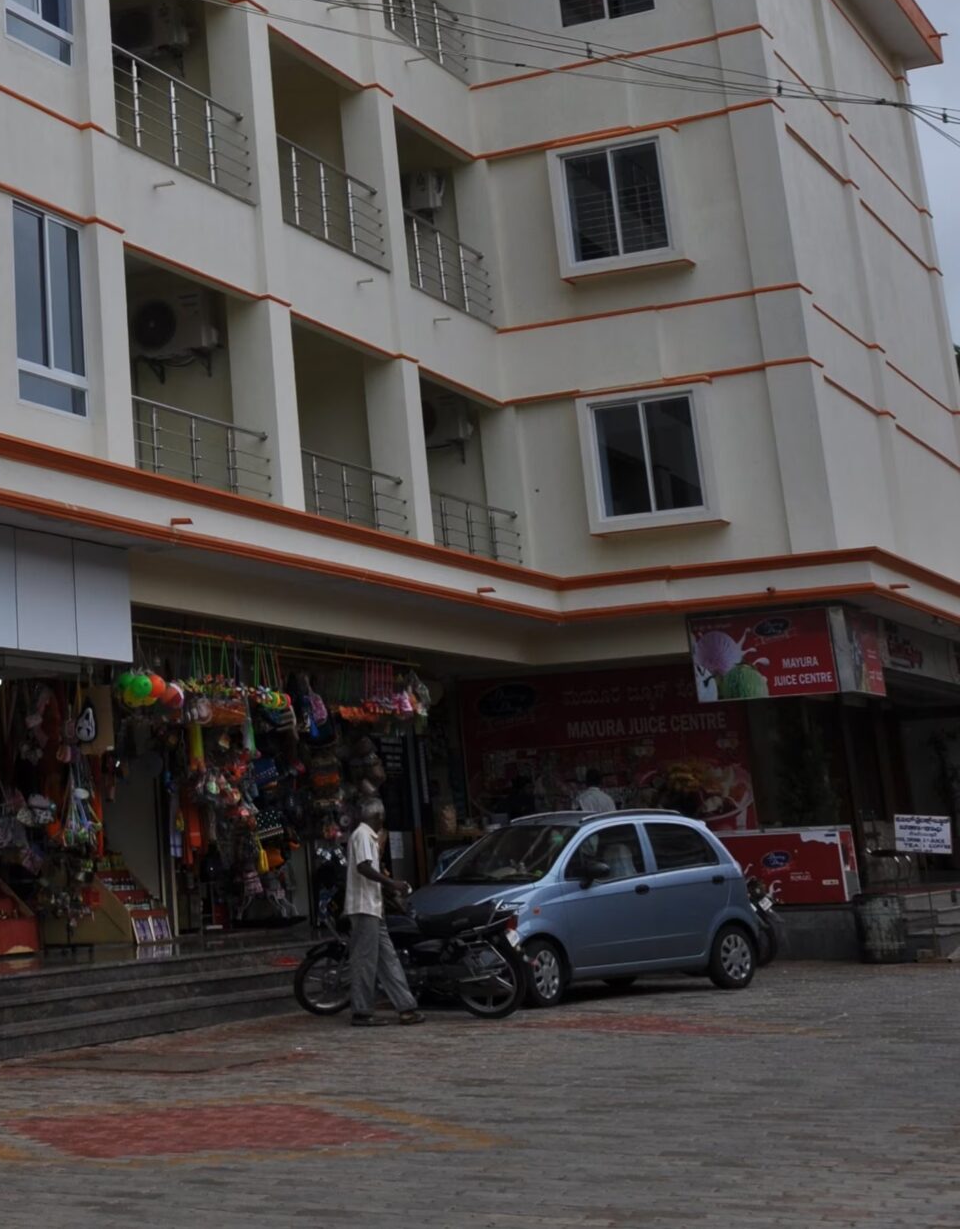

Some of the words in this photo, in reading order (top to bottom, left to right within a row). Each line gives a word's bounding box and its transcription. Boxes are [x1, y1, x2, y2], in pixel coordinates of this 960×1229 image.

[782, 656, 819, 669] MAYURA
[773, 673, 797, 687] JUICE
[798, 671, 833, 685] CENTRE
[567, 717, 626, 739] MAYURA
[628, 715, 667, 736] JUICE
[670, 712, 726, 733] CENTRE
